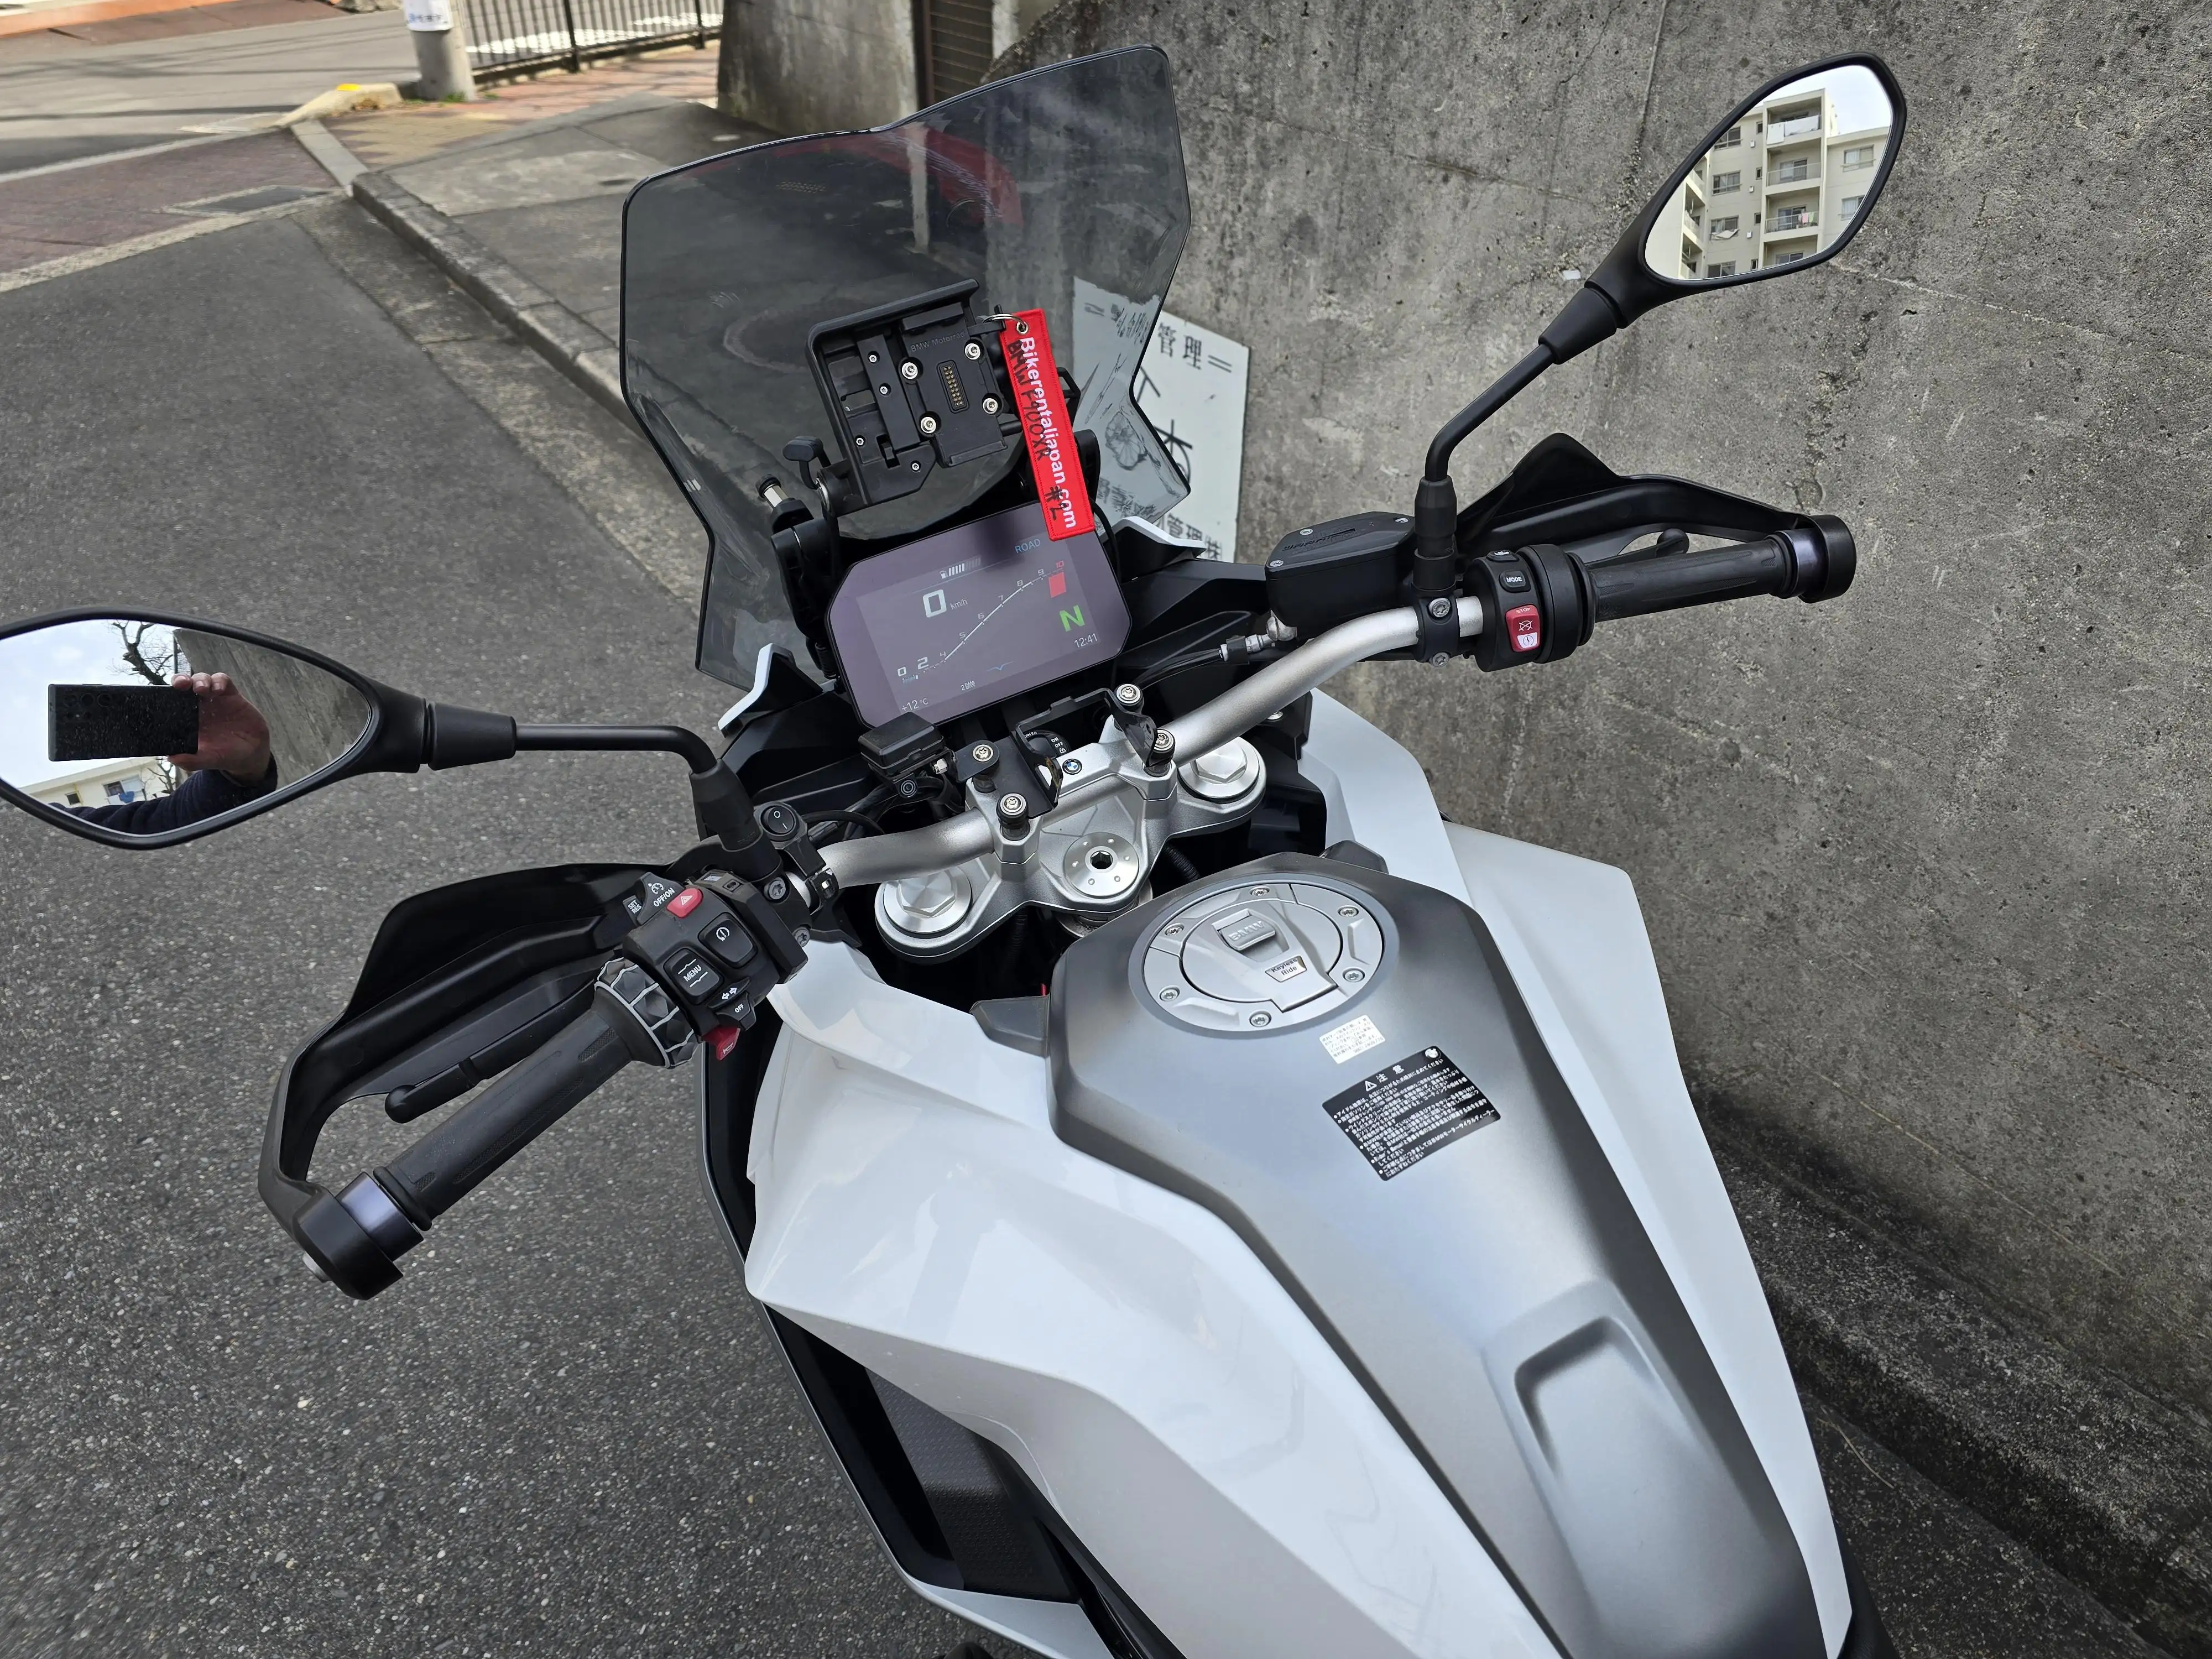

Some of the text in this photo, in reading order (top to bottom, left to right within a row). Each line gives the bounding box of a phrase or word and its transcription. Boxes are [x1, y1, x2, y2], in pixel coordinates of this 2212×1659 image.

[910, 341, 929, 352] BMW
[1019, 337, 1077, 528] Bikerentaljapan.com
[1015, 539, 1041, 553] ROAD
[1056, 560, 1065, 568] 10
[923, 589, 968, 618] 0 km/h
[1060, 605, 1085, 632] N
[1074, 633, 1098, 648] 12:41
[917, 657, 929, 670] 2
[898, 667, 907, 677] 0
[628, 899, 638, 909] SET
[653, 888, 675, 907] OFF/ON
[631, 904, 641, 914] RES
[1229, 921, 1264, 941] BMW
[1271, 958, 1297, 973] Keyless
[1281, 966, 1297, 975] Ride
[683, 964, 702, 982] MENU
[735, 1003, 744, 1013] OFF
